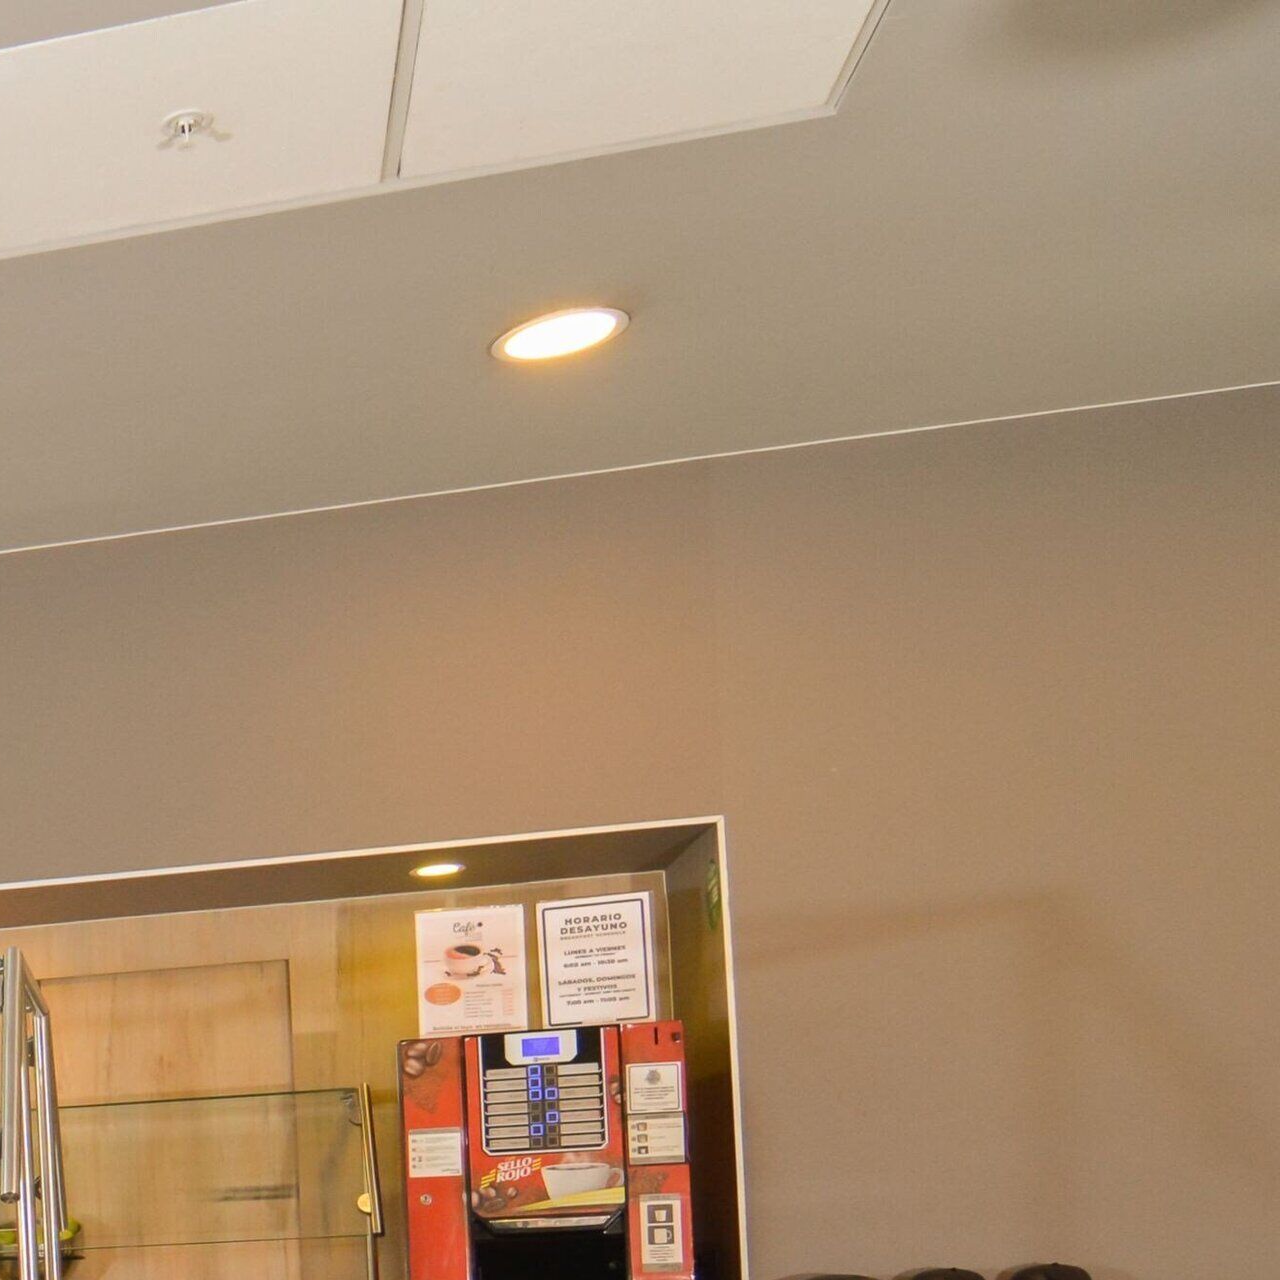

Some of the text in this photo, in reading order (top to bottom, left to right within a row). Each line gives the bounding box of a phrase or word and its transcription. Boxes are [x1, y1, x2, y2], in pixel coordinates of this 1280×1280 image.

[564, 913, 621, 925] HORARIO
[560, 922, 627, 935] DESAYUNO
[595, 945, 626, 953] VIERNES
[596, 974, 635, 982] DOMINGOS
[497, 1157, 532, 1171] SELLO
[496, 1166, 532, 1183] ROJO
